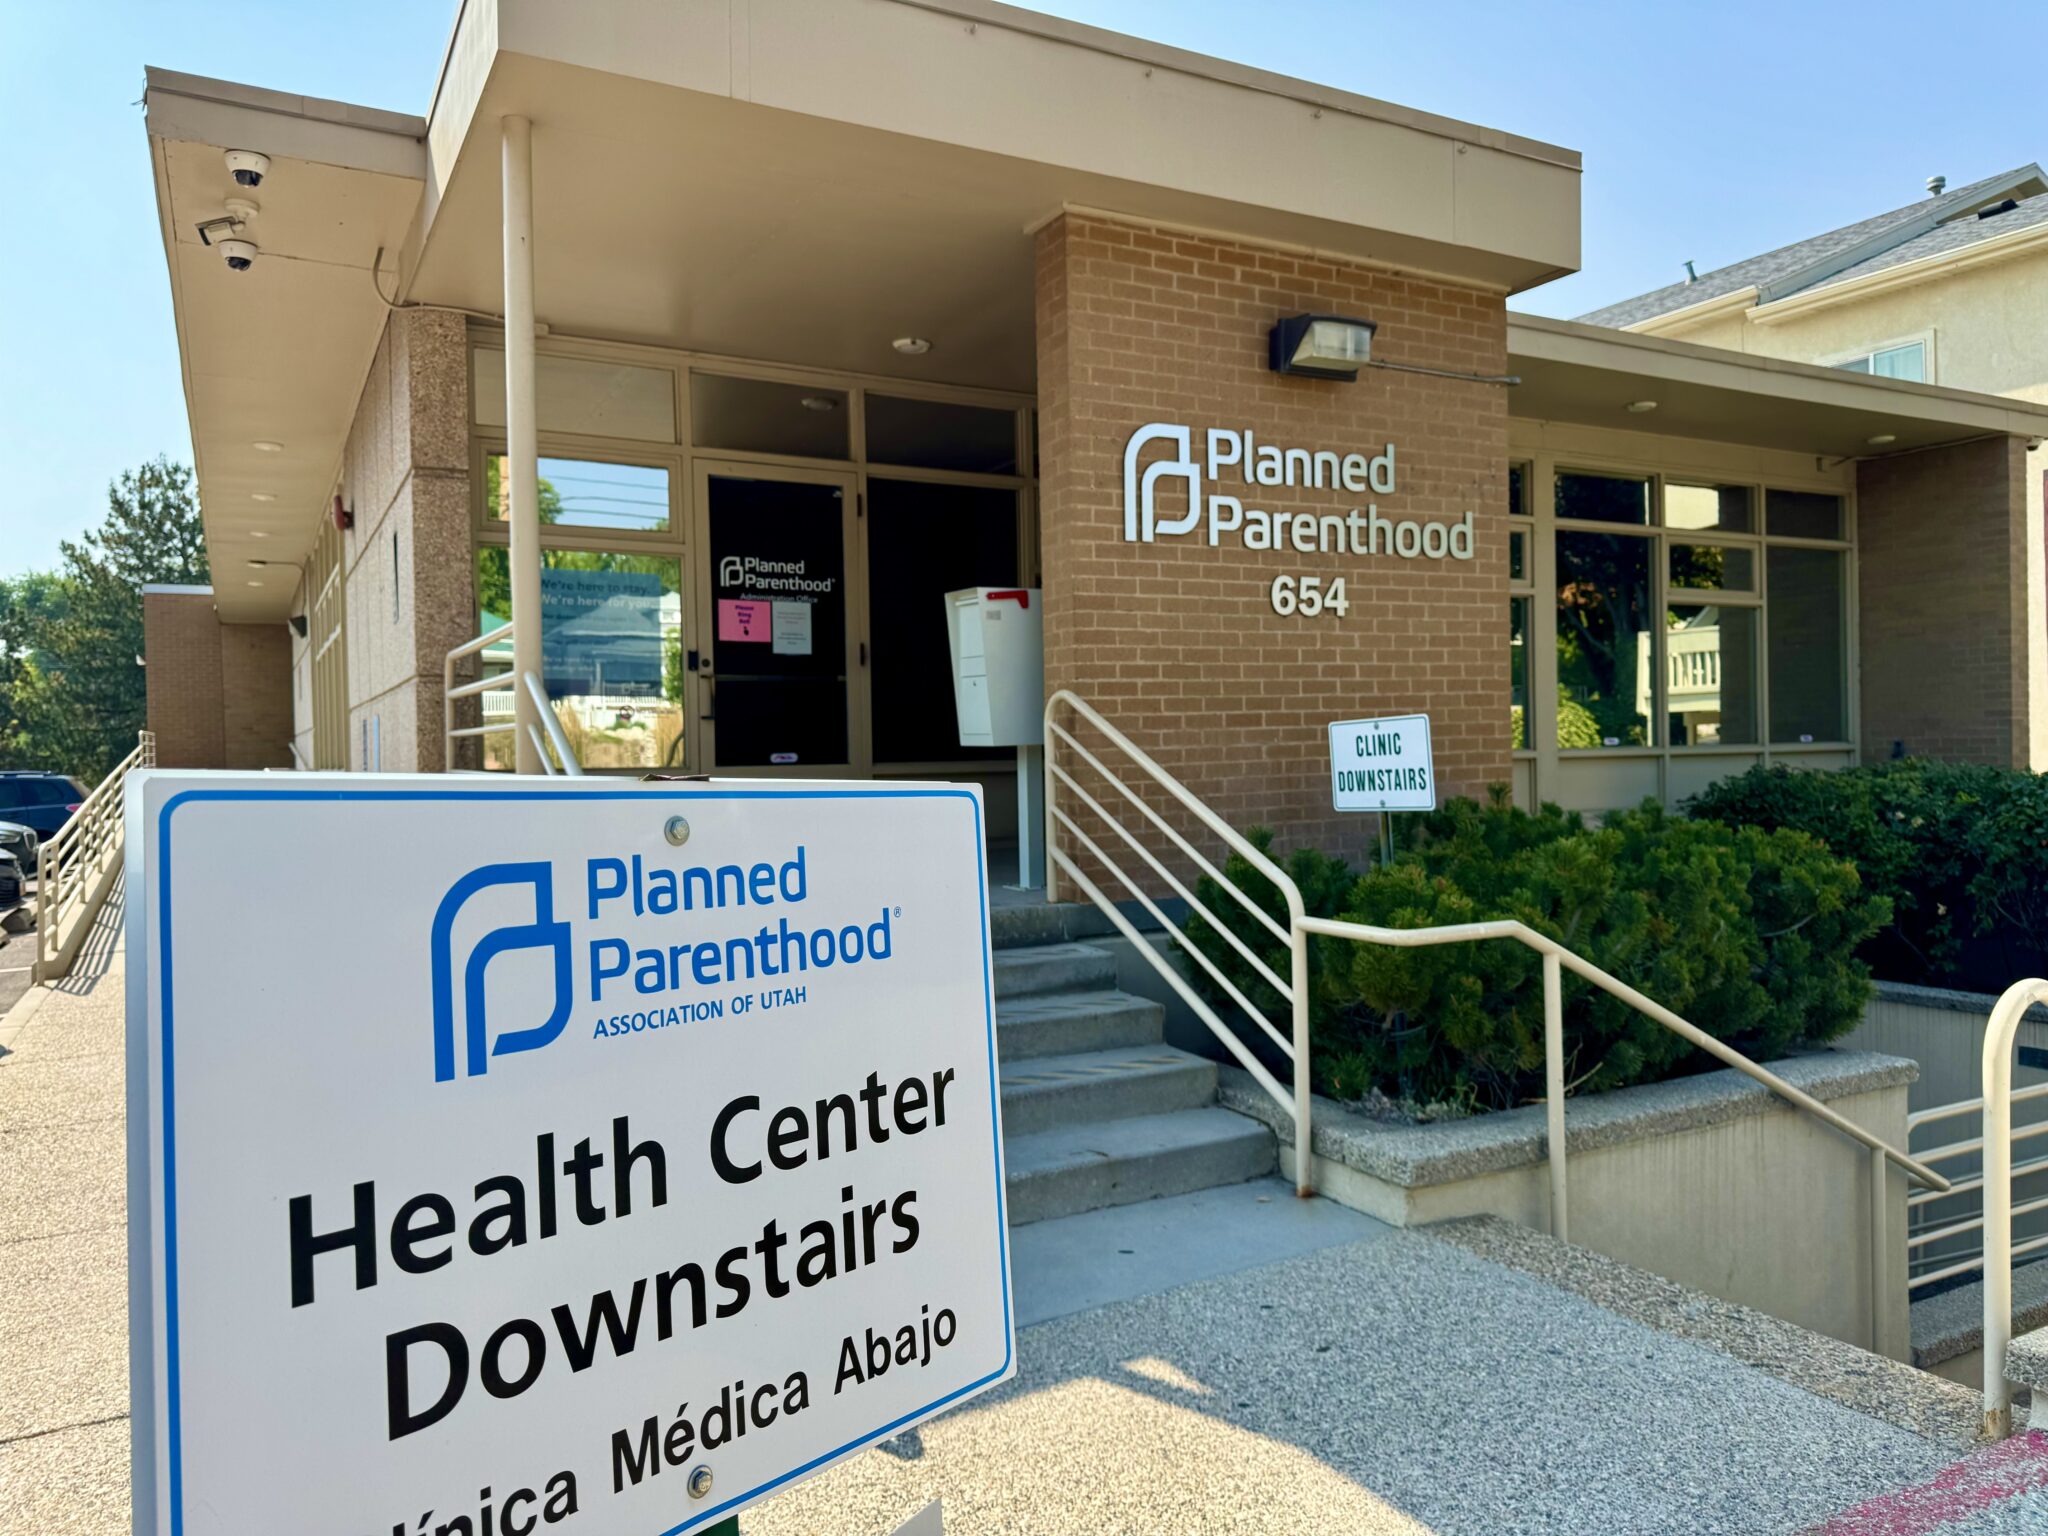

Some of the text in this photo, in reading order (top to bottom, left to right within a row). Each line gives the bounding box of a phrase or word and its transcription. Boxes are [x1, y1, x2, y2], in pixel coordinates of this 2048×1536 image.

[1207, 427, 1396, 494] Planned
[1208, 495, 1474, 559] Parenthood
[577, 581, 602, 592] here
[608, 583, 620, 593] to
[744, 556, 805, 575] Planned
[1271, 574, 1349, 617] 654
[1355, 732, 1402, 758] CLINIC
[1337, 767, 1427, 793] DOWNSTAIRS
[587, 845, 807, 920] Planned
[593, 986, 807, 1040] ASSOCIATION OF UTAH
[289, 1067, 955, 1309] Health Center
[385, 1184, 920, 1442] Downstairs
[611, 1370, 810, 1495] Médica
[833, 1304, 958, 1396] Abajo
